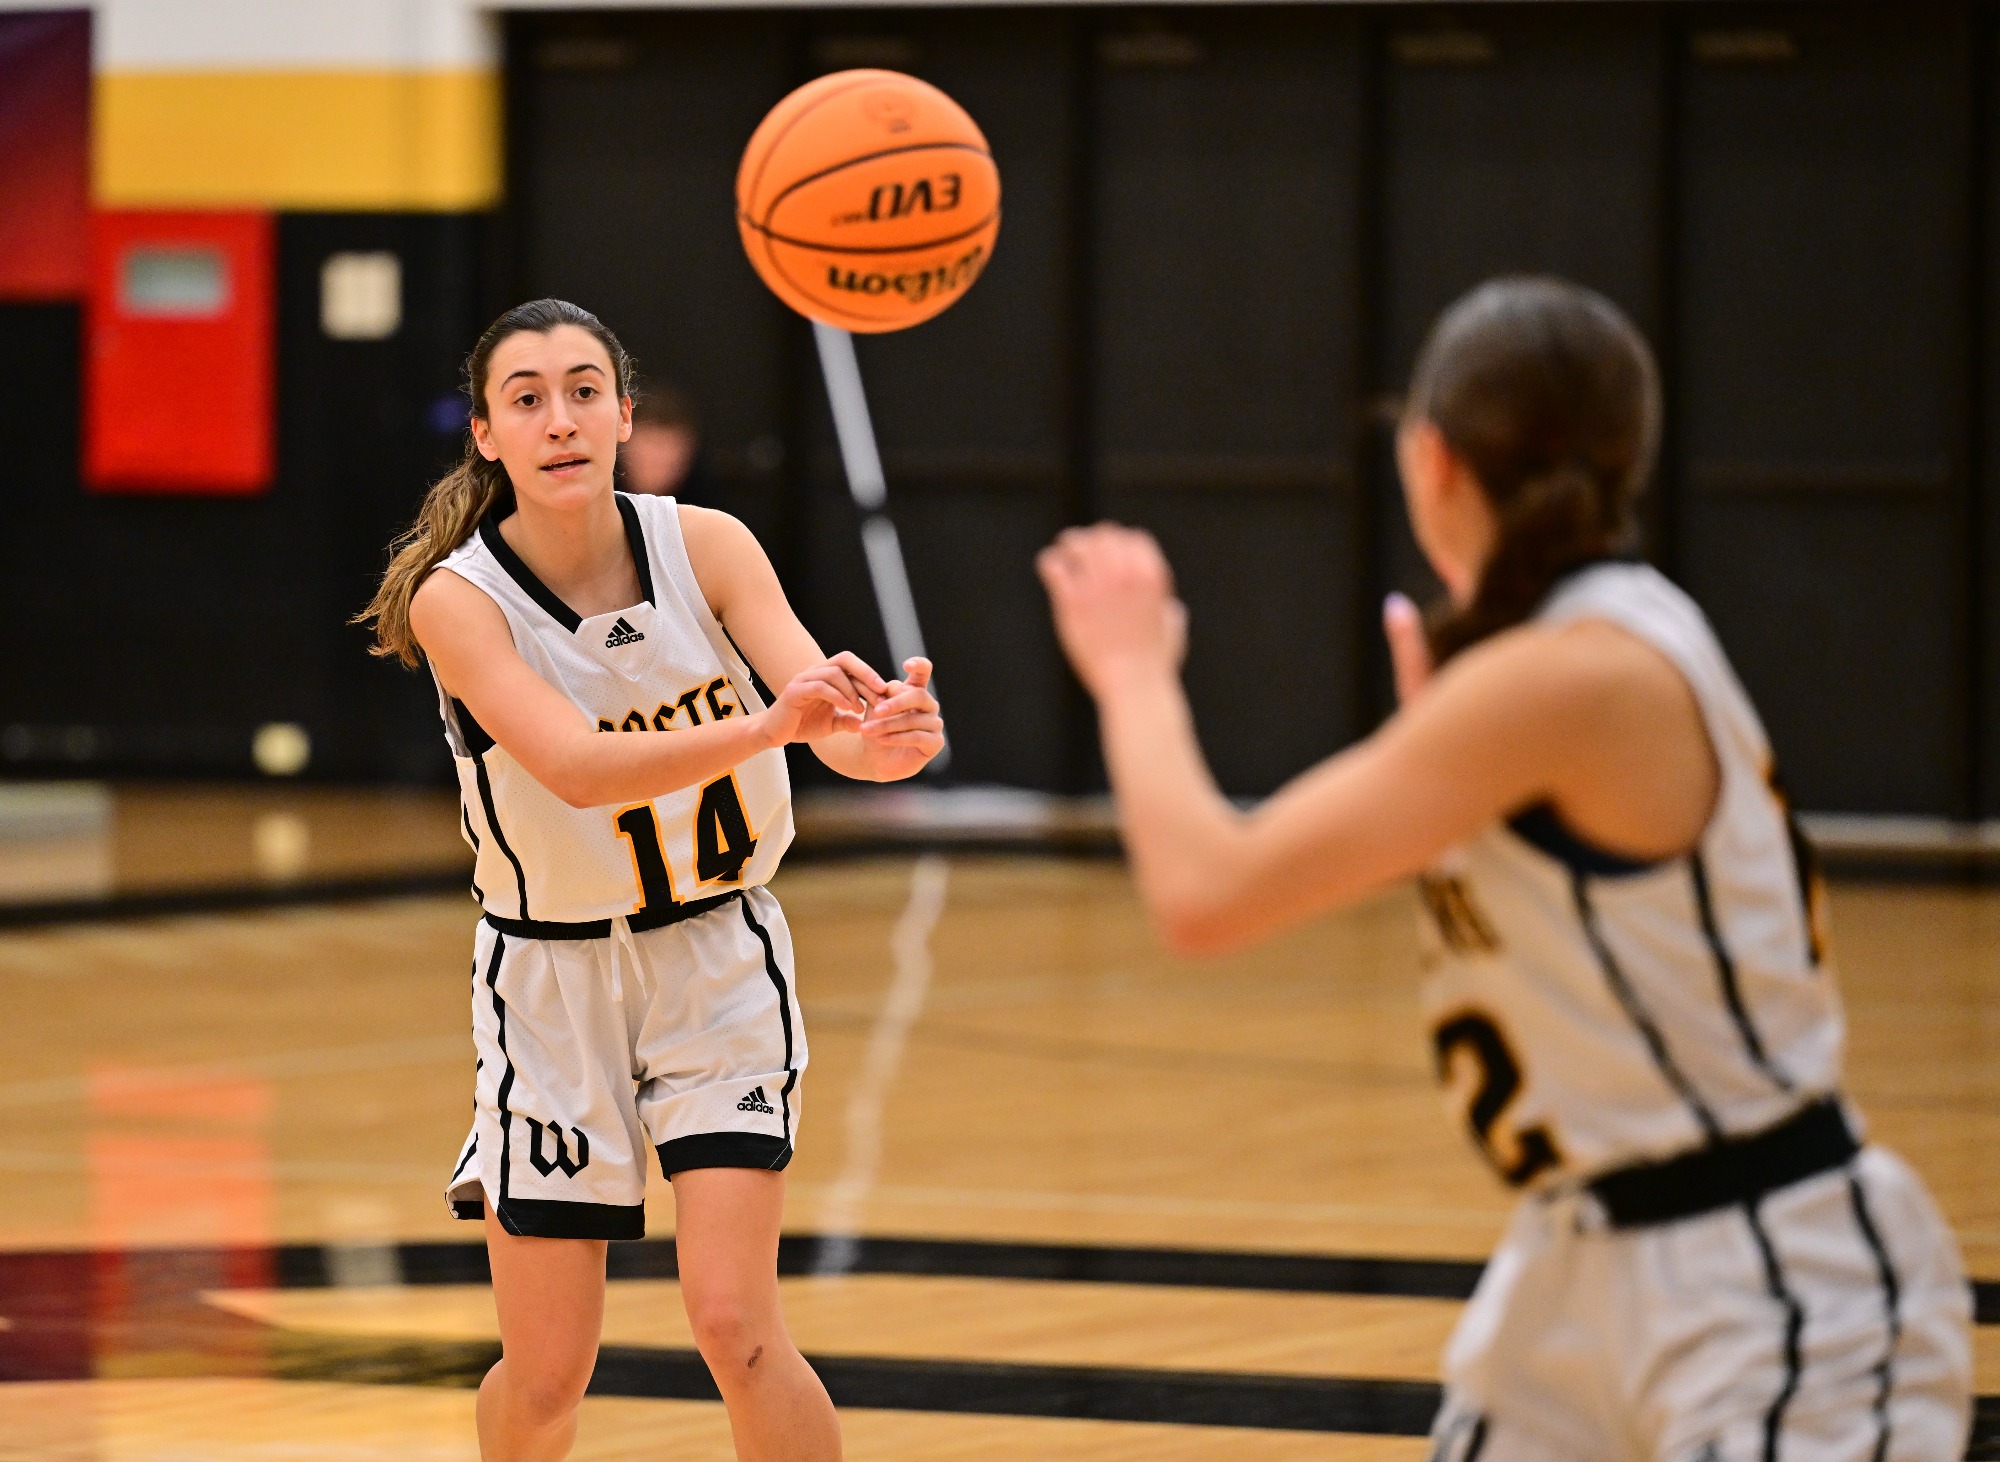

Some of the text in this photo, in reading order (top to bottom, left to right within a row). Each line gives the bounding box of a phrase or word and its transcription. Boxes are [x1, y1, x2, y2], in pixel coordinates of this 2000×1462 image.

[826, 246, 984, 305] Wilson
[604, 630, 646, 650] adidas
[612, 768, 761, 915] 14
[736, 1098, 775, 1116] adidas
[525, 1115, 590, 1180] W
